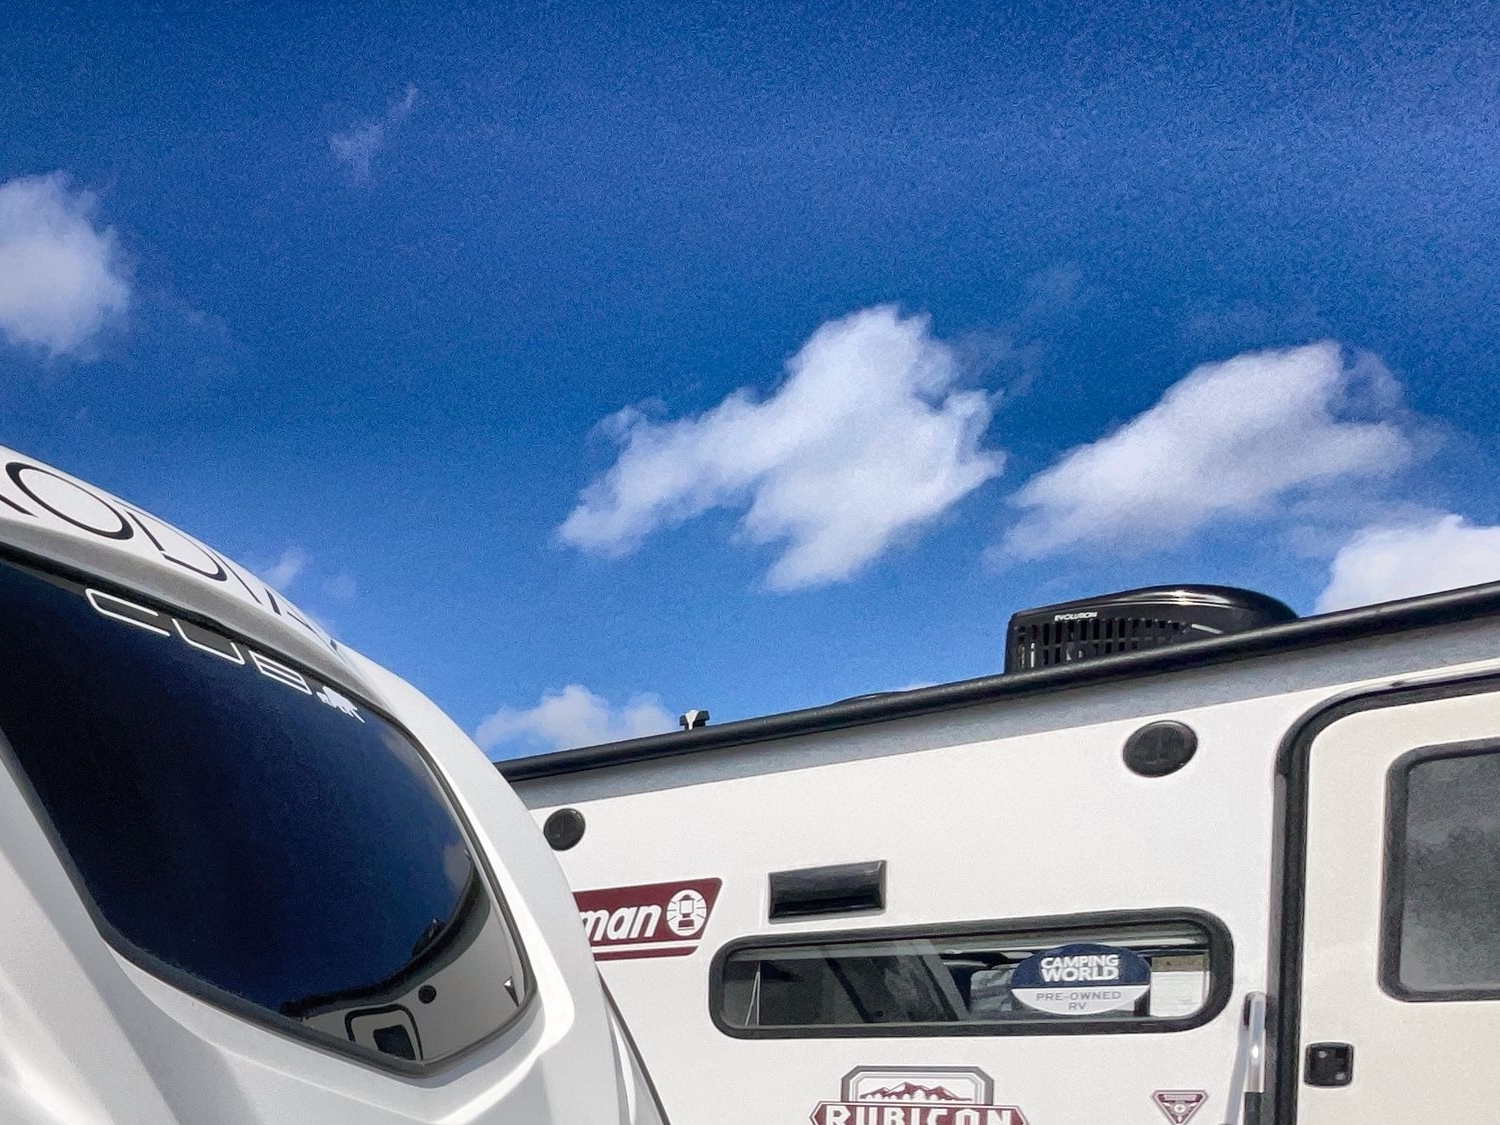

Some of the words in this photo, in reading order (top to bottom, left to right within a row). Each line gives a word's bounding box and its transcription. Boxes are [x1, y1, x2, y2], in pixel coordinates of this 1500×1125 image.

[86, 588, 311, 692] CUB
[1041, 954, 1119, 968] CAMPING
[1041, 967, 1119, 982] WORLD
[1036, 991, 1122, 1002] PRE-OWNED
[1068, 1002, 1087, 1010] RV
